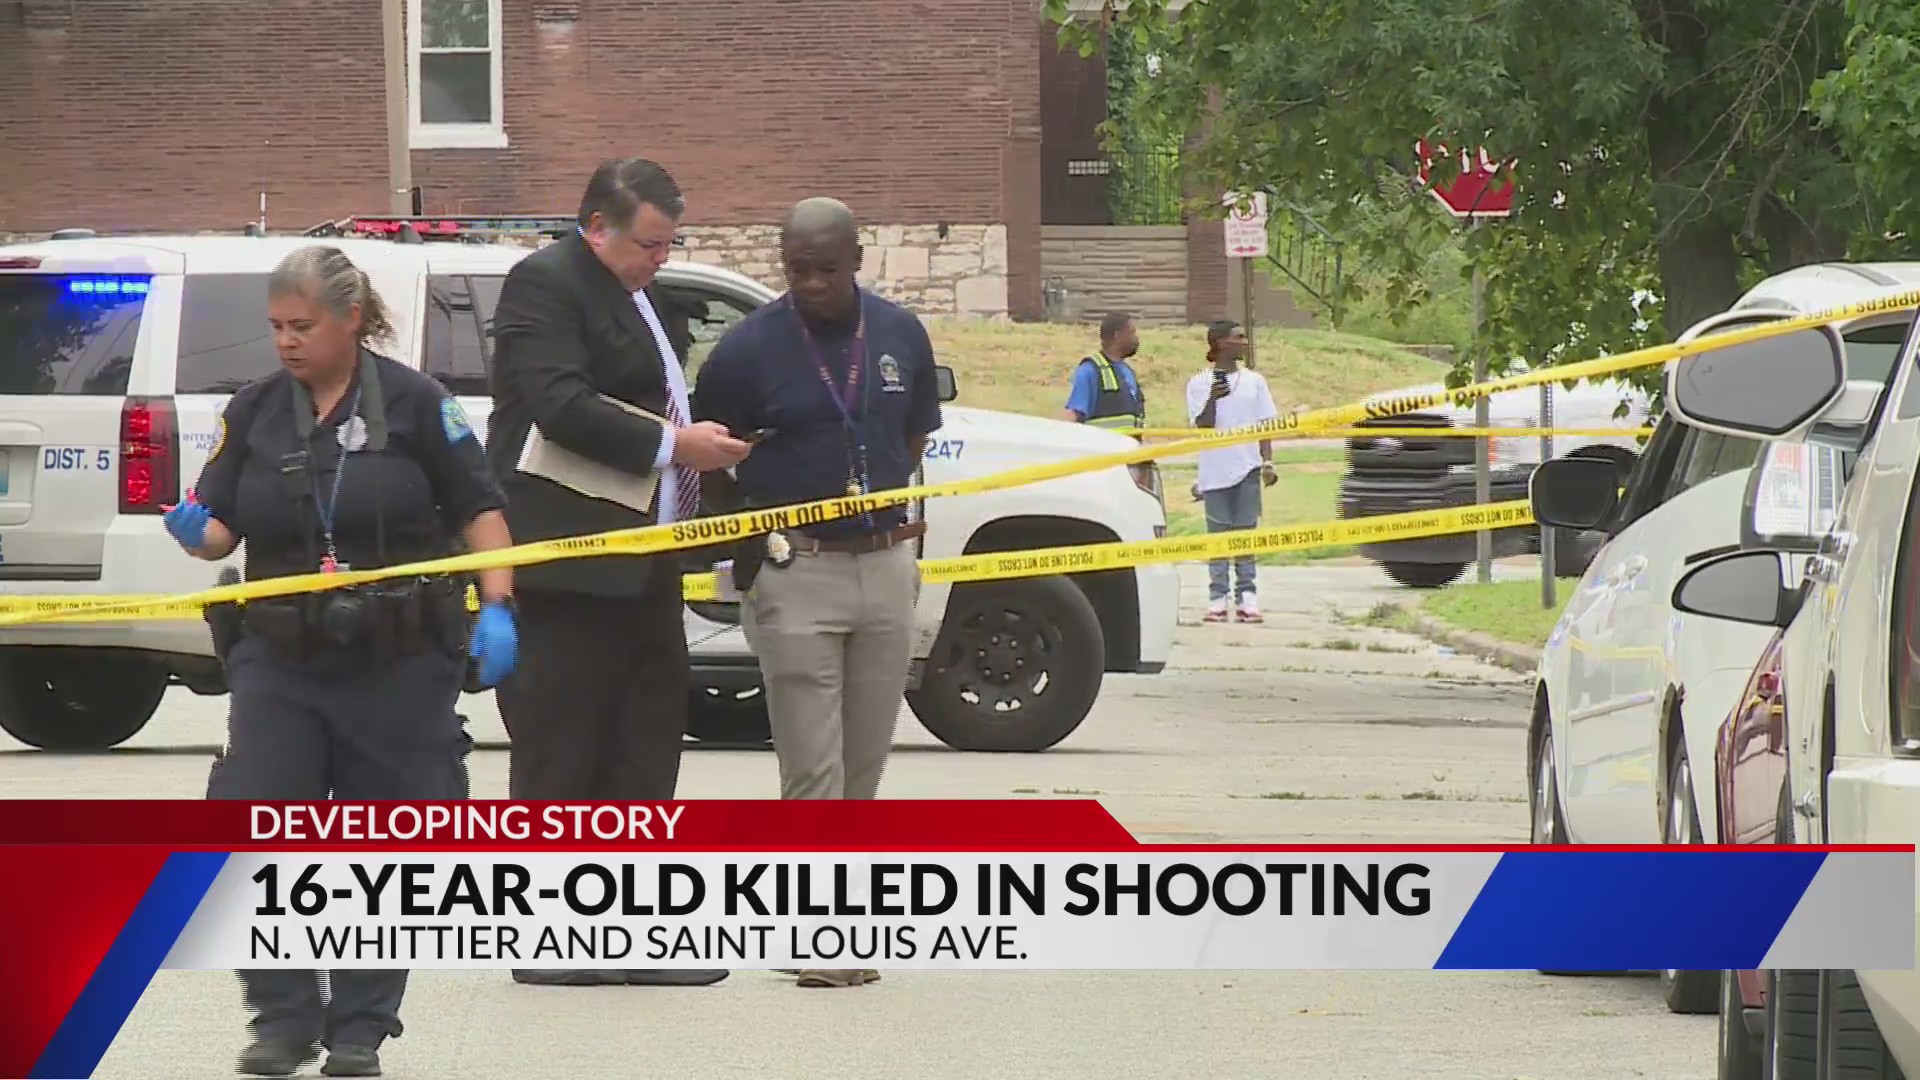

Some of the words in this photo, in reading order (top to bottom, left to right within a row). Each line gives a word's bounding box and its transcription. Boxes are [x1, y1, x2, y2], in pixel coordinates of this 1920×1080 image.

[44, 447, 88, 470] DIST.
[96, 449, 110, 470] 5
[799, 504, 825, 526] DO
[832, 498, 877, 521] LINE
[1486, 510, 1502, 523] NOT
[1503, 508, 1513, 521] DO
[749, 510, 789, 533] NOT
[1460, 512, 1485, 526] CROSS
[672, 518, 741, 543] CROSS
[1297, 529, 1324, 544] POLICE
[1227, 537, 1252, 551] CROSS
[1253, 535, 1267, 548] NOT
[1268, 534, 1279, 547] DO
[1280, 531, 1297, 545] LINE
[998, 558, 1022, 572] CROSS
[1024, 557, 1038, 570] NOT
[1039, 556, 1050, 569] DO
[1050, 554, 1068, 568] LINE
[1067, 551, 1094, 566] POLICE
